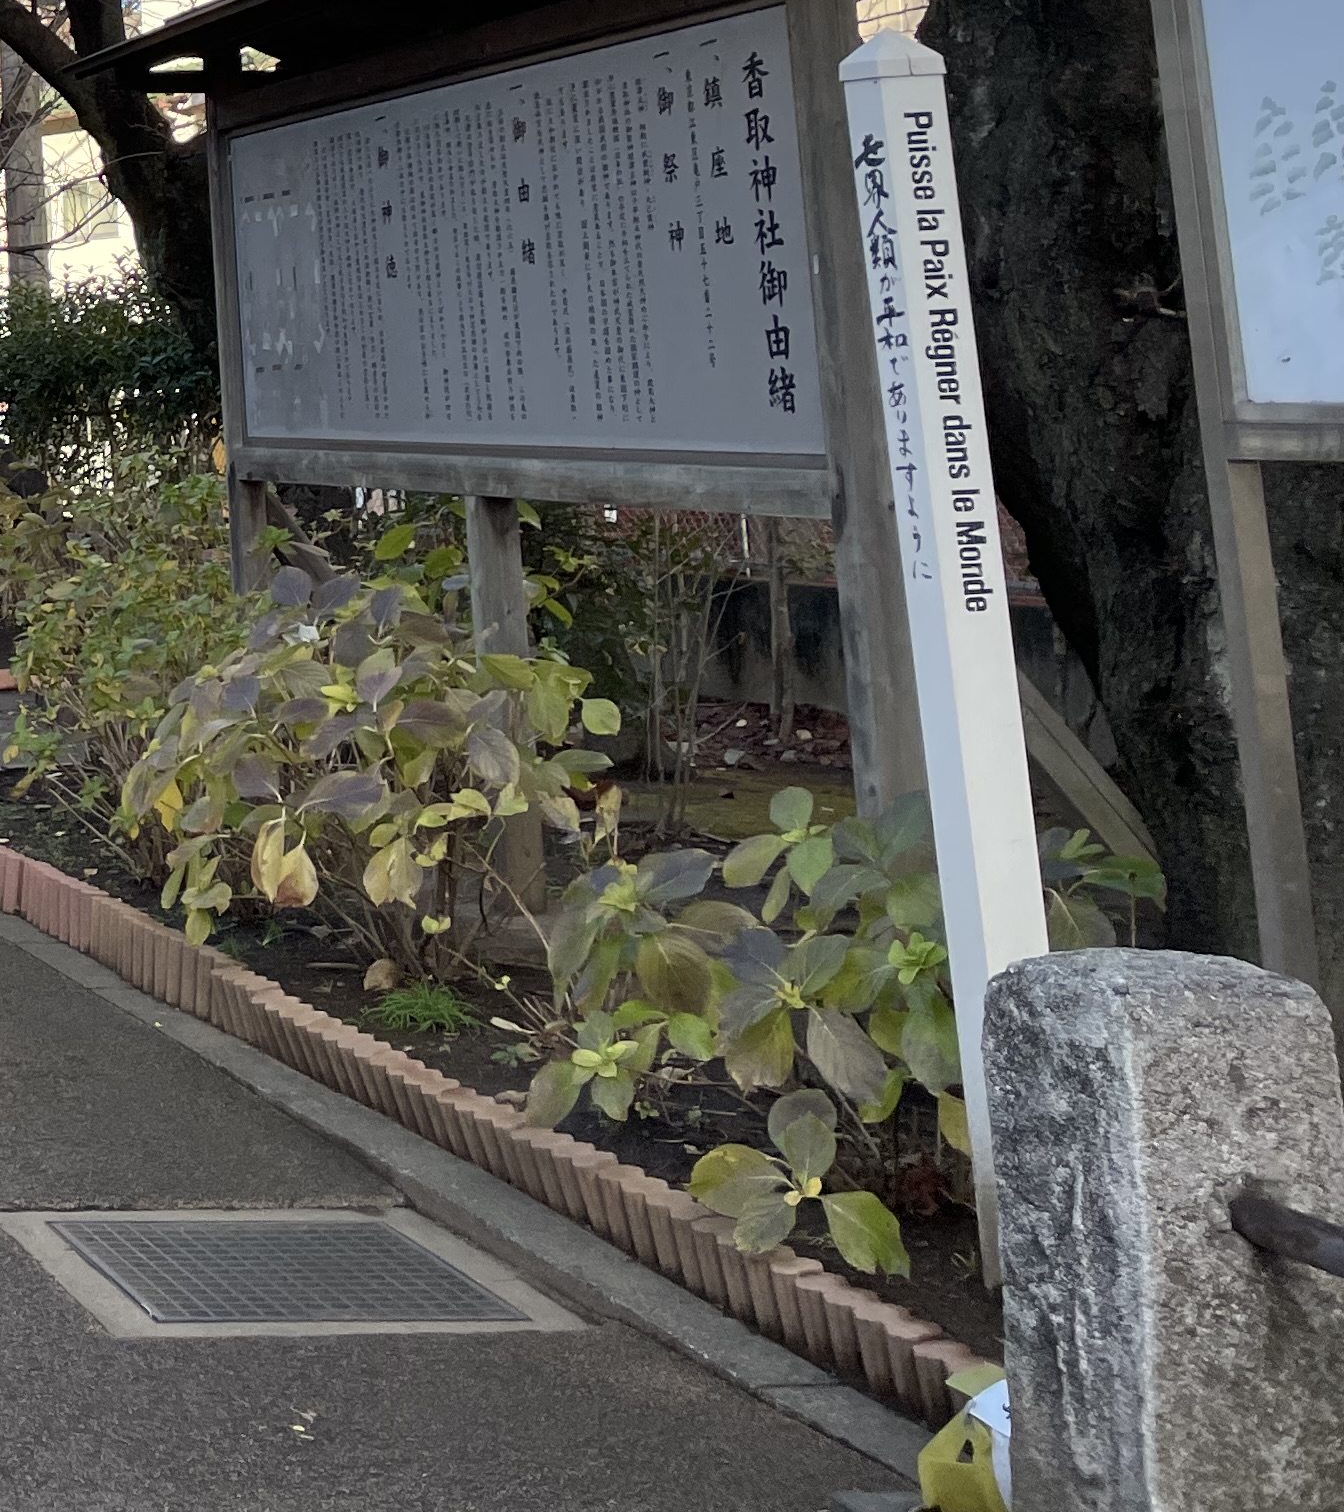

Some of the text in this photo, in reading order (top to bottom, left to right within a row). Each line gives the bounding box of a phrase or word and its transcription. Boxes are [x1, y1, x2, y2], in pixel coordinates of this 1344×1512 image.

[742, 51, 796, 414] 香取神社御由緒
[854, 133, 933, 581] 世界人類が平和でありますように
[904, 111, 994, 613] Puisse la Paix Régner dans le Monde
